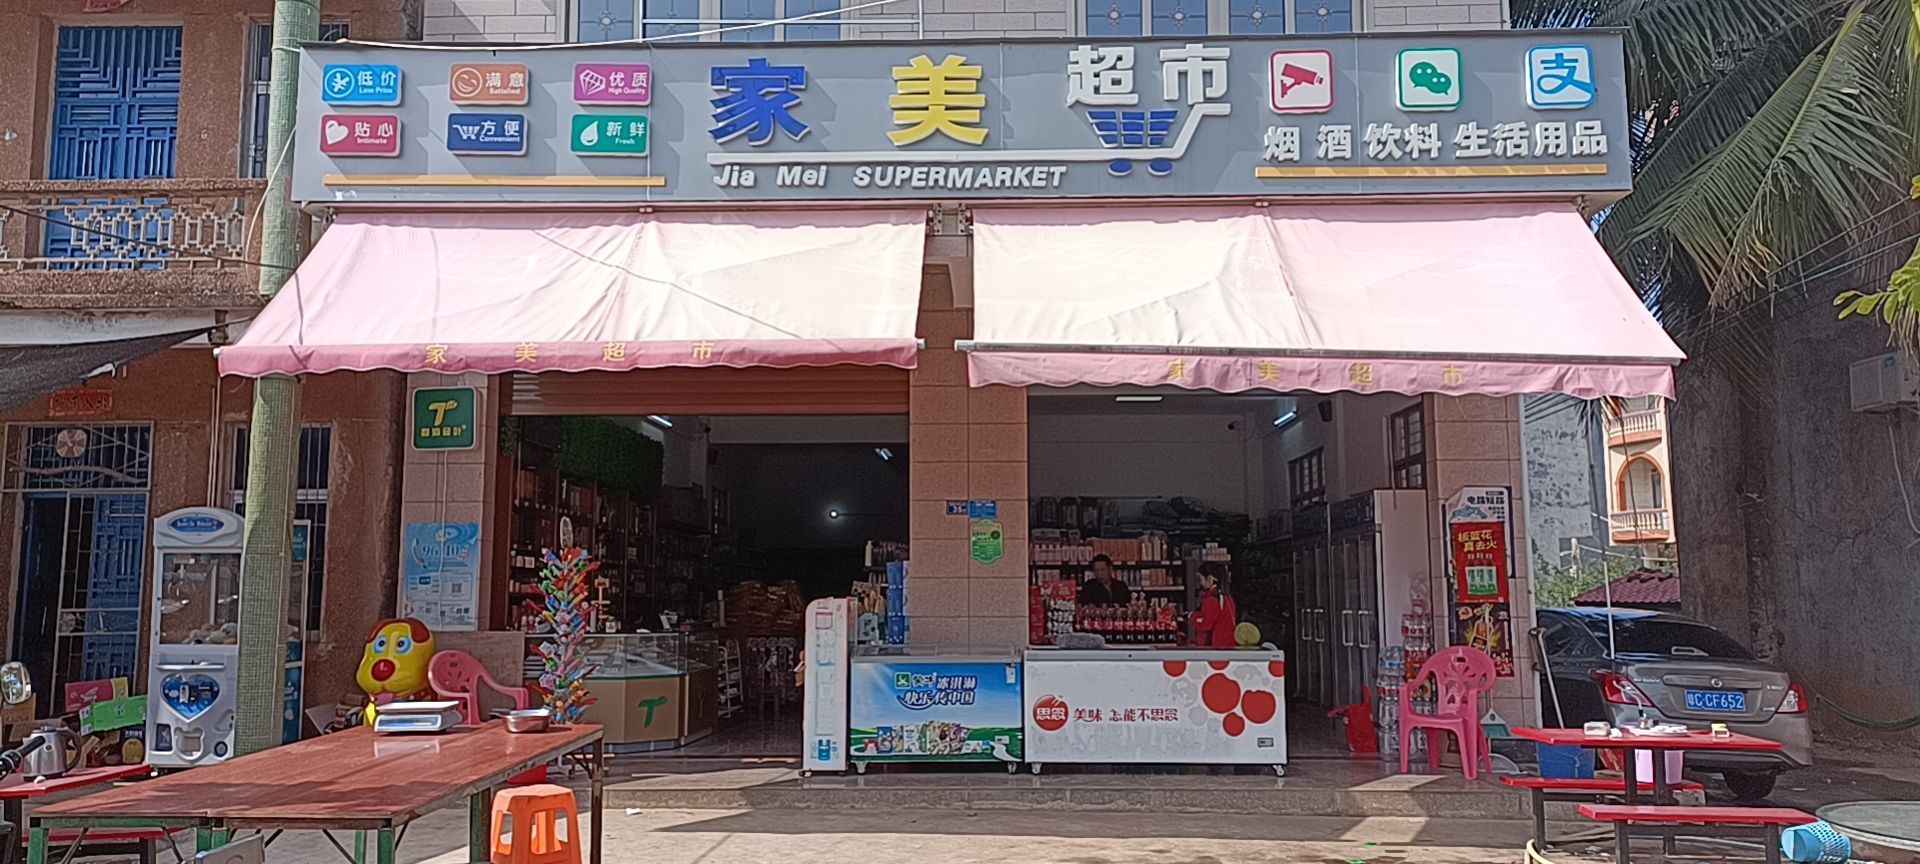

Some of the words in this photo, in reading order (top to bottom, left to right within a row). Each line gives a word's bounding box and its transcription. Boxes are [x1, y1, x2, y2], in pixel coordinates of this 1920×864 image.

[357, 69, 397, 88] 低价
[485, 71, 525, 89] 满意
[608, 71, 647, 88] 优质
[358, 86, 375, 94] Low
[376, 86, 393, 94] Price
[608, 88, 622, 96] High
[623, 88, 646, 96] Quality
[354, 120, 394, 138] 贴心
[480, 119, 520, 136] 方便
[605, 120, 646, 138] 新鲜
[356, 136, 388, 145] Intimate
[479, 134, 521, 143] Convenient
[614, 136, 636, 145] Fresh
[713, 164, 756, 187] Jia
[775, 164, 827, 188] Mei
[852, 164, 1067, 189] SUPERMARKET
[1035, 707, 1066, 721] 思念
[1073, 707, 1103, 723] 美味
